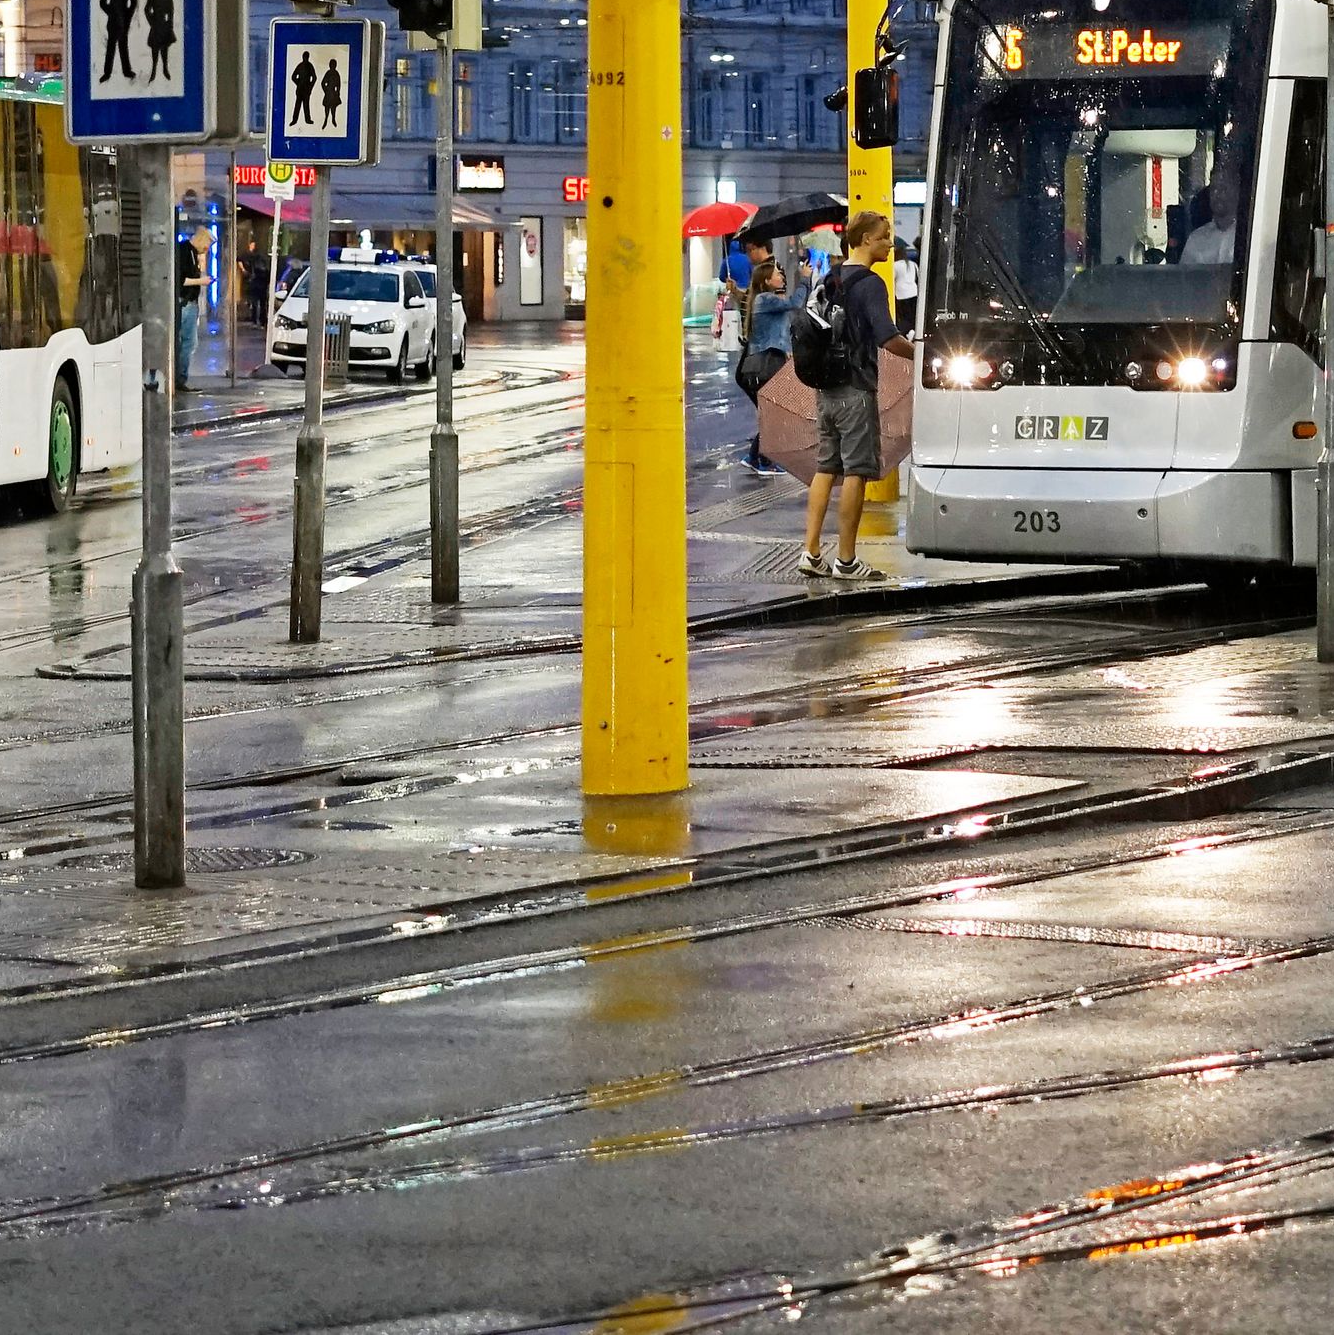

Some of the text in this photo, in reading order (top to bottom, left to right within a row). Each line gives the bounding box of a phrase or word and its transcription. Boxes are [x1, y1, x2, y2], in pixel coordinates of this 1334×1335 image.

[1006, 28, 1181, 71] 6 St.Peter
[1016, 417, 1106, 440] GRAZ
[1013, 510, 1061, 533] 203
